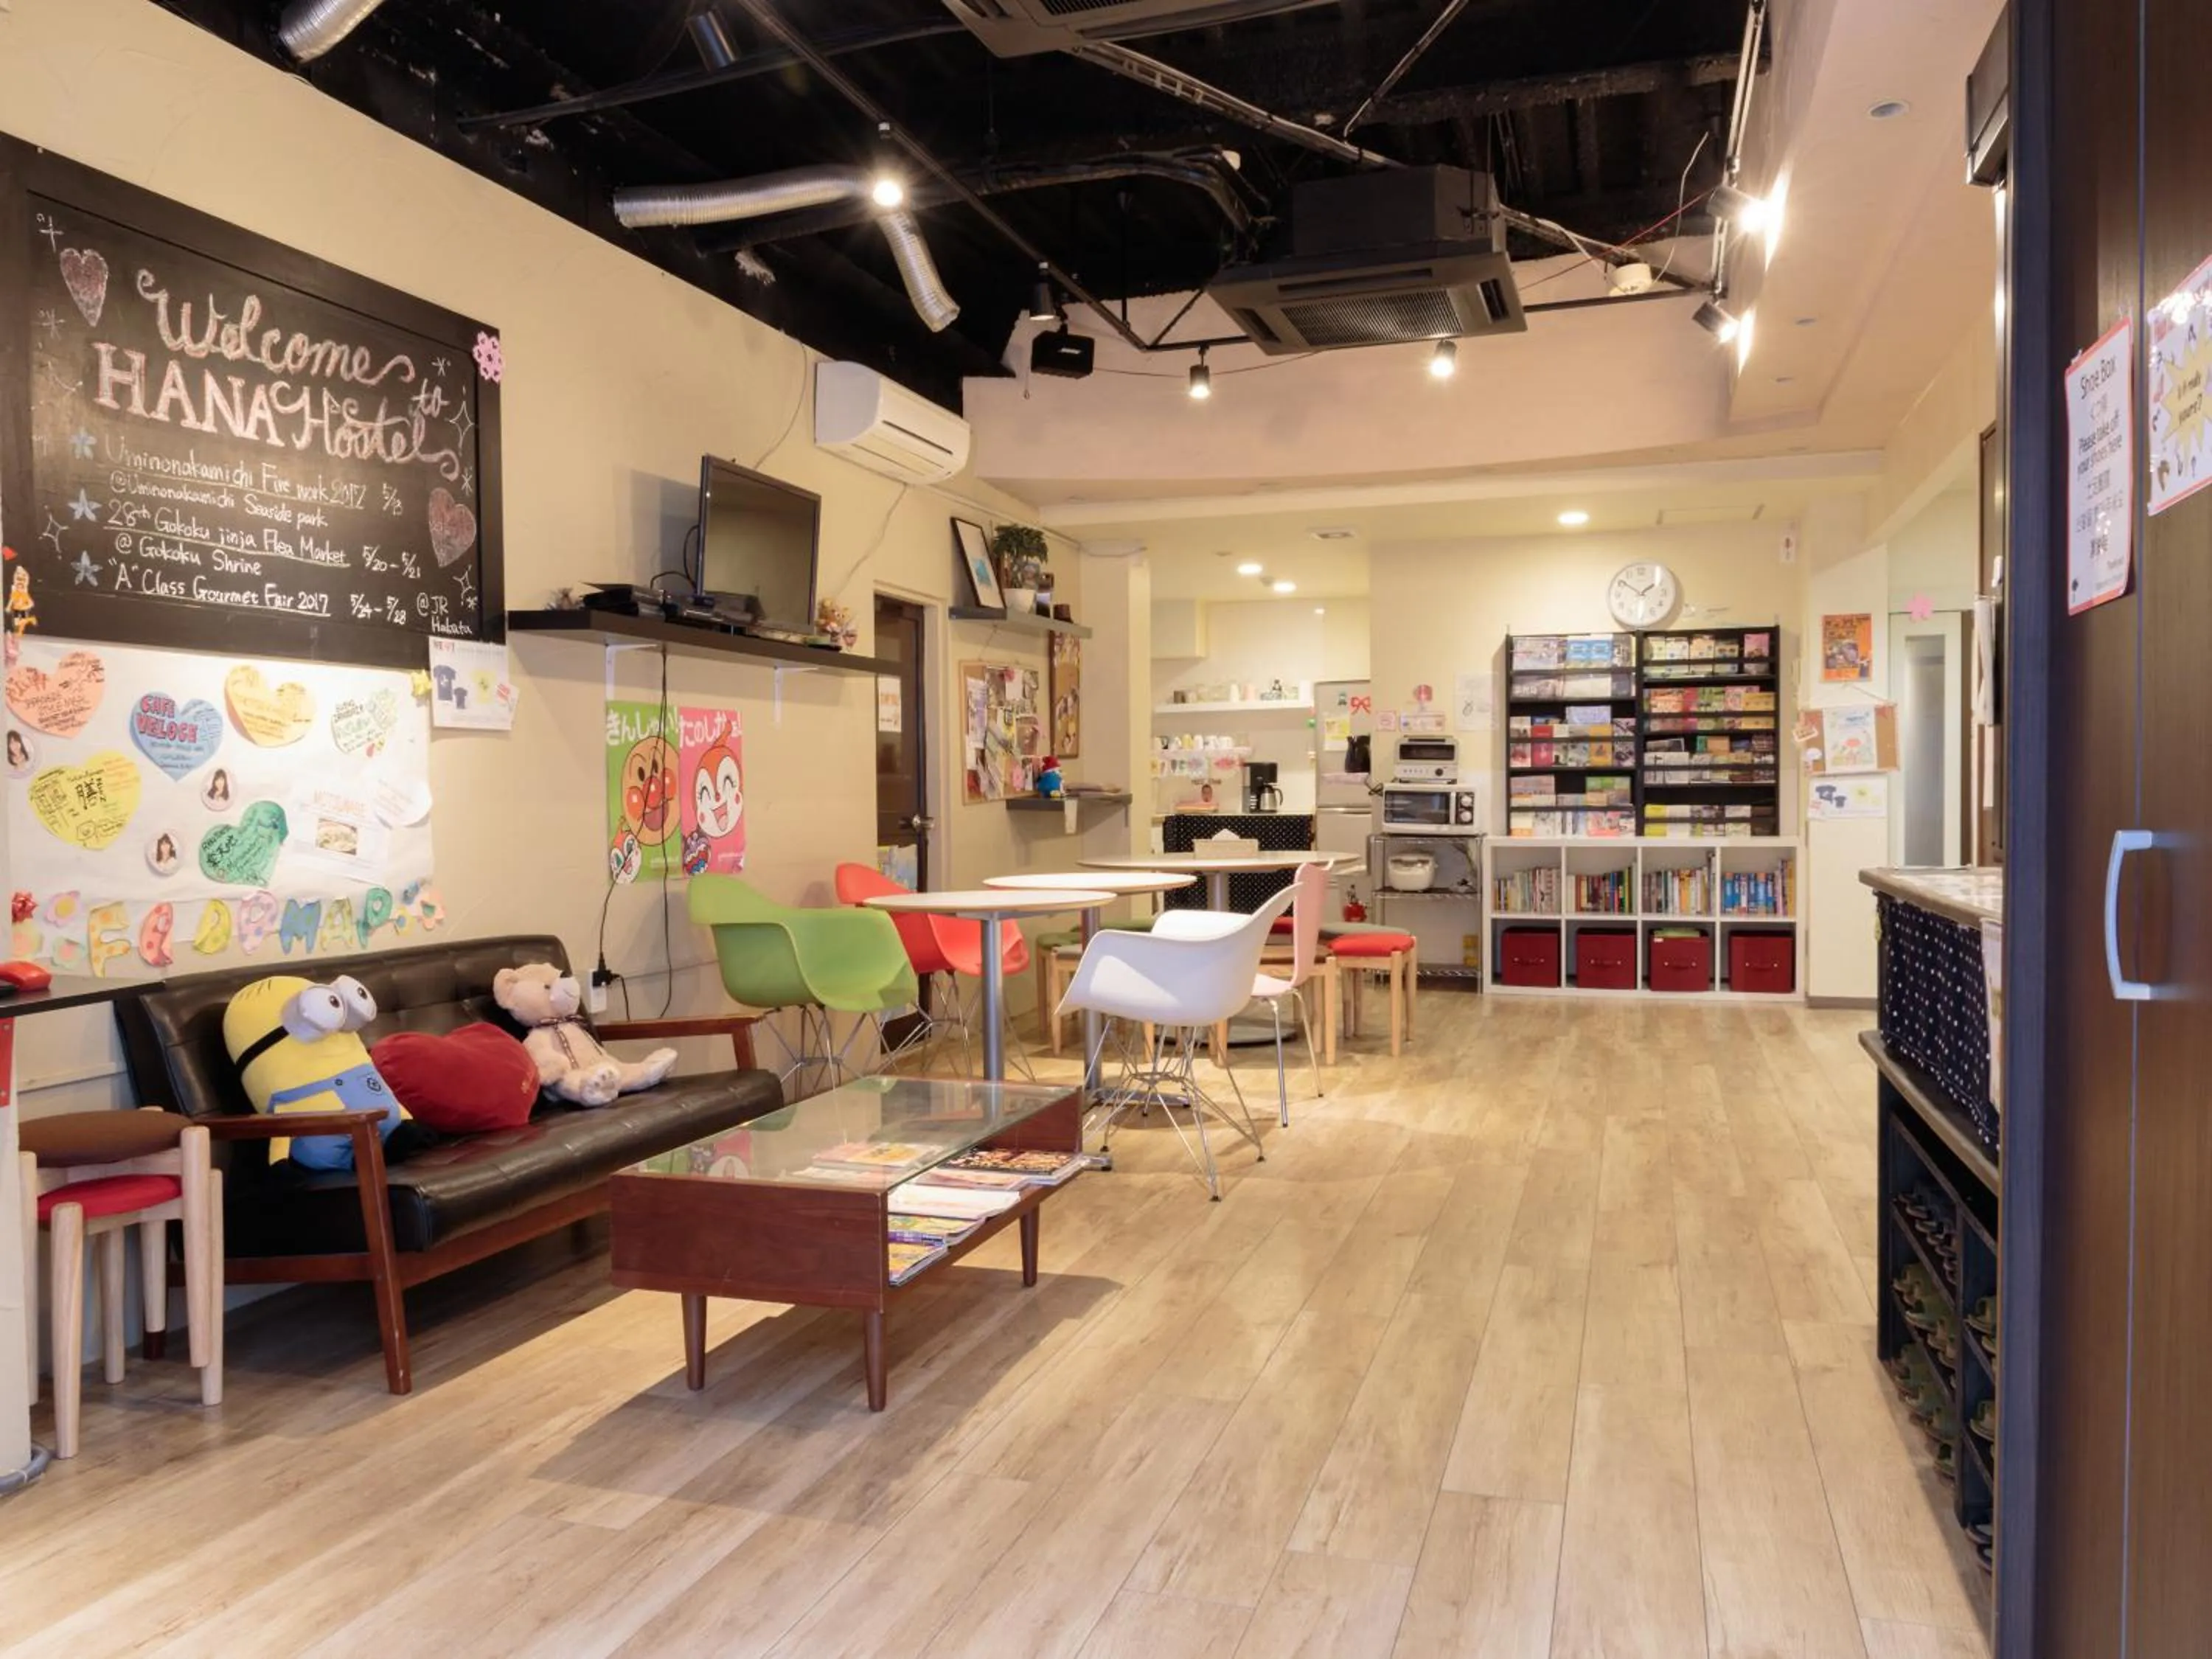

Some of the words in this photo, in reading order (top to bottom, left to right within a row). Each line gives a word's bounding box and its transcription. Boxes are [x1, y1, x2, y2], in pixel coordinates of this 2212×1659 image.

[136, 268, 416, 388] Welcome
[410, 378, 451, 418] to
[2080, 369, 2099, 400] Shoe
[2100, 354, 2117, 383] Box
[91, 341, 286, 448] HANA
[268, 380, 460, 482] Hostel
[105, 434, 254, 489] Uminonakamichi
[261, 462, 291, 493] Fire
[296, 474, 330, 503] work
[331, 479, 367, 510] 2017
[107, 498, 152, 527] 28th
[154, 506, 211, 541] Gokoku
[262, 528, 295, 557] Flea
[299, 535, 347, 563] Market
[243, 493, 293, 523] Seaside
[296, 506, 329, 530] park
[139, 535, 202, 567] Gokoku
[212, 548, 262, 577] Shrine
[141, 568, 186, 596] Class
[192, 574, 260, 605] Gourmet
[264, 582, 295, 609] Fair
[296, 591, 329, 615] 2017
